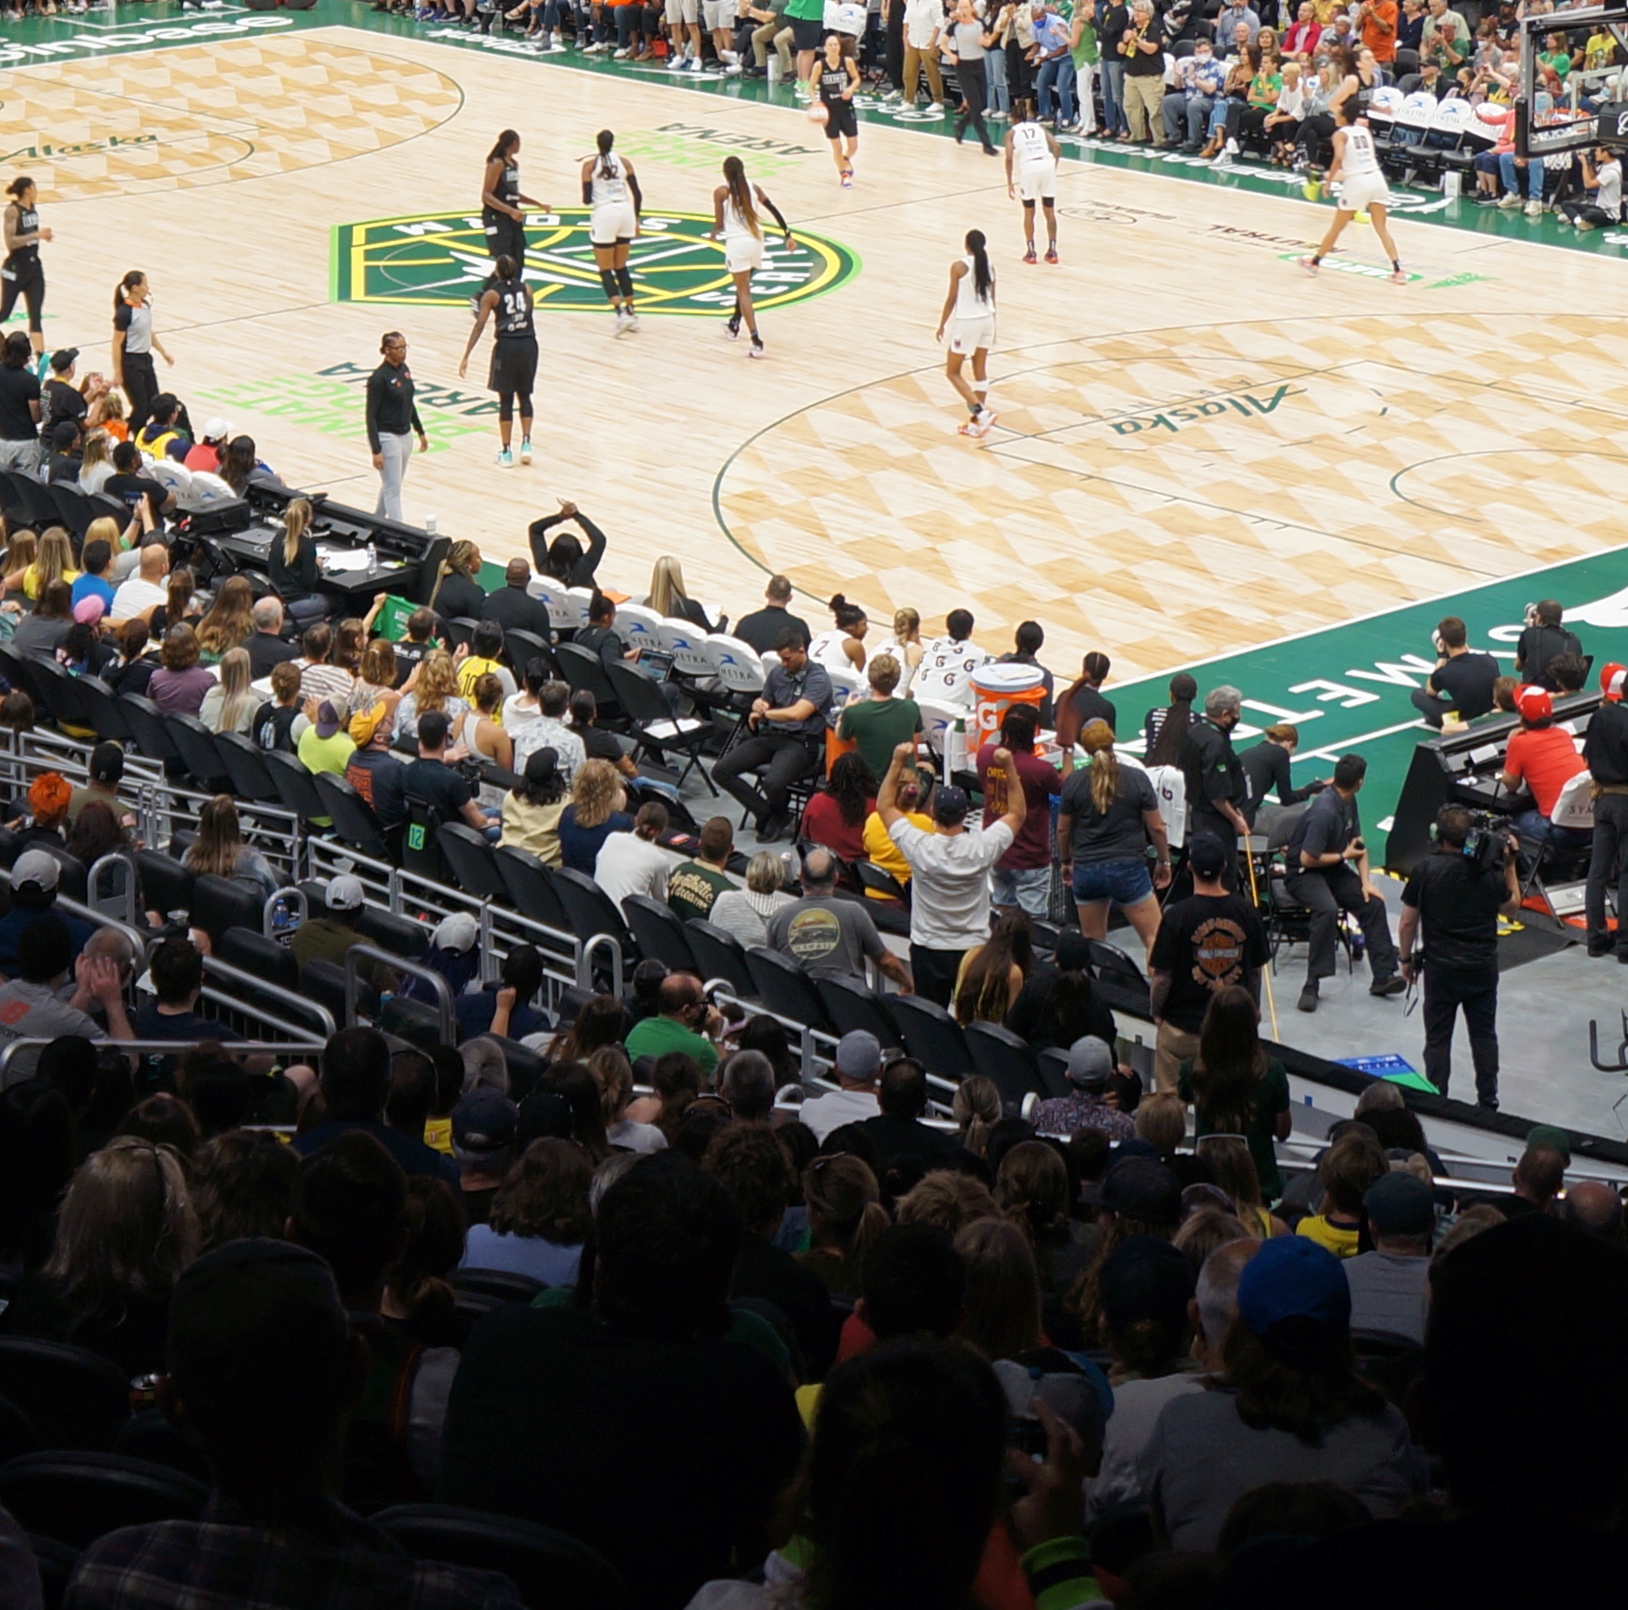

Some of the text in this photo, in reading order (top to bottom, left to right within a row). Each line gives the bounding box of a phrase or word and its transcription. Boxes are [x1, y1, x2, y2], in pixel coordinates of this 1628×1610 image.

[1022, 128, 1035, 139] 17
[504, 292, 526, 315] 24
[1108, 383, 1308, 436] Alaska
